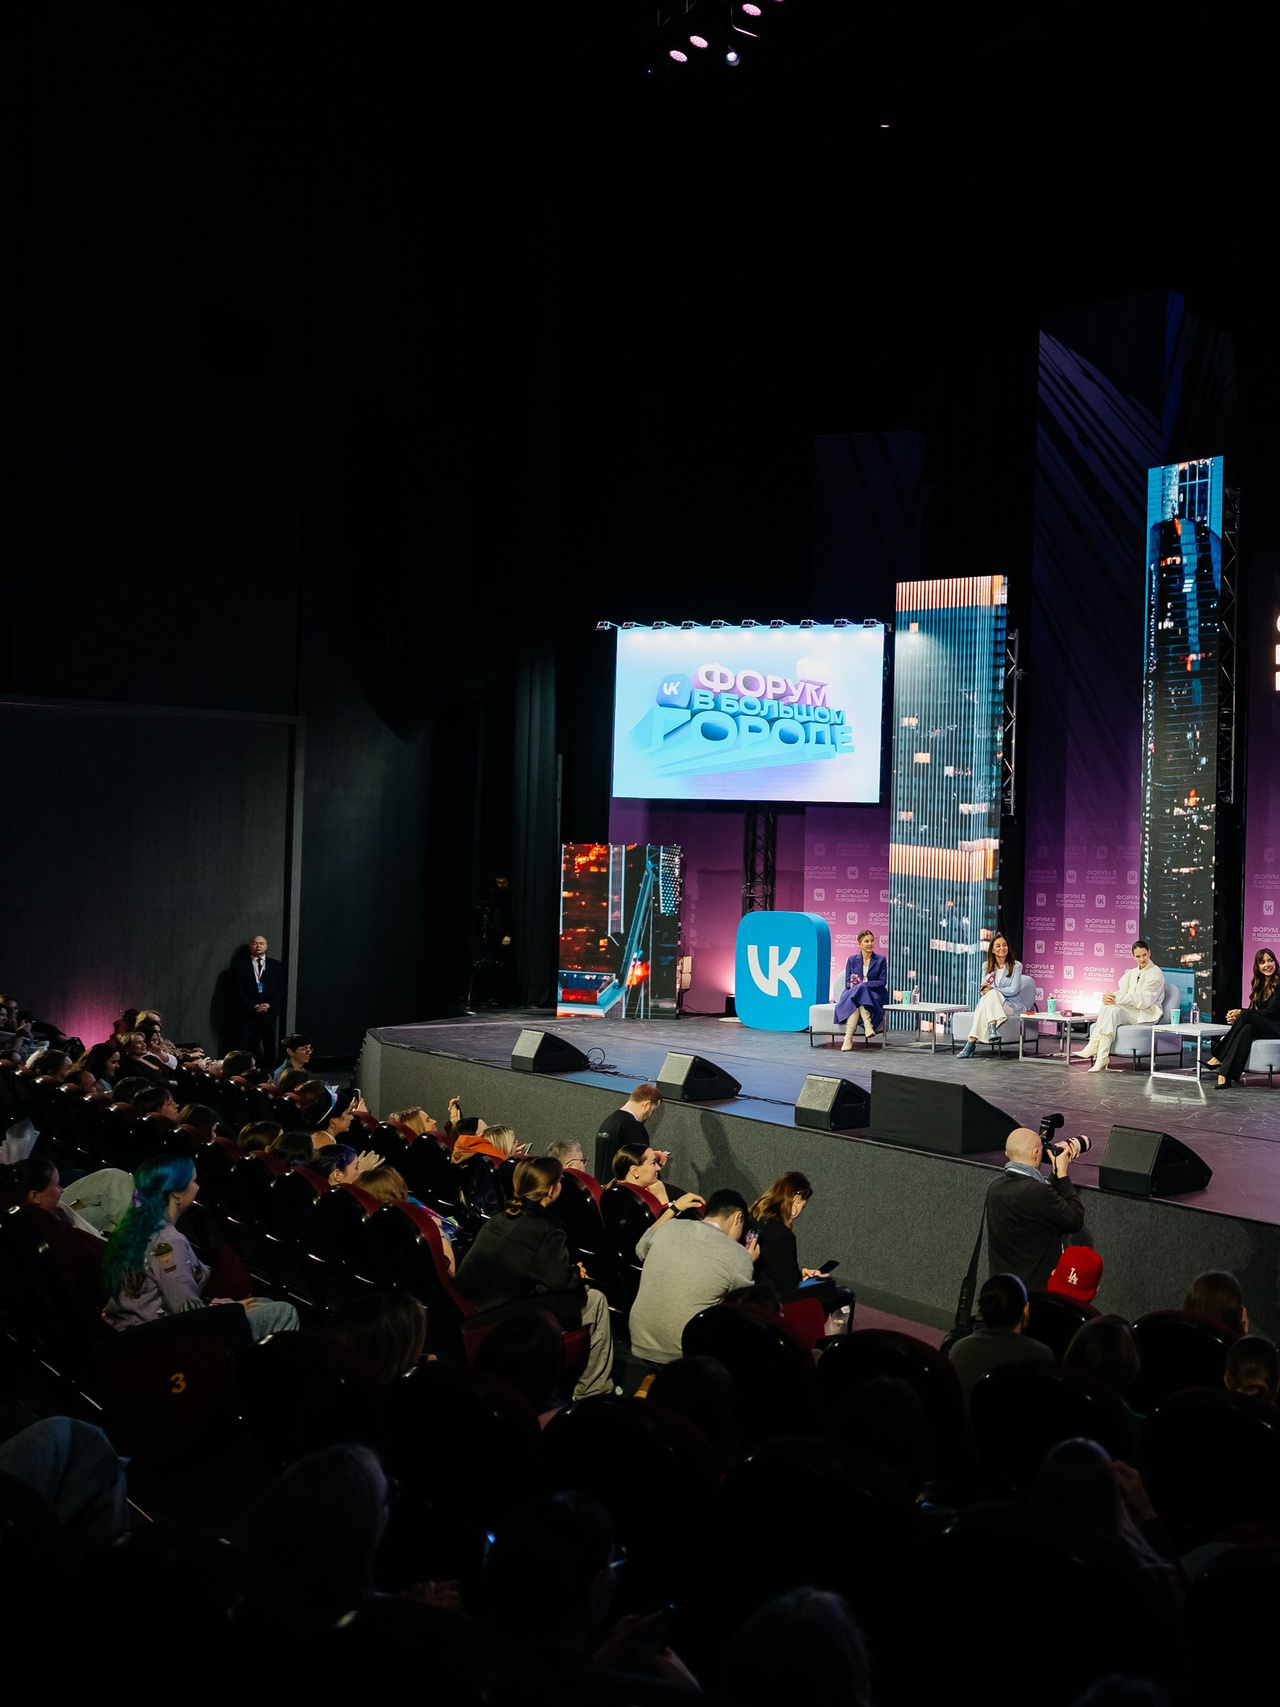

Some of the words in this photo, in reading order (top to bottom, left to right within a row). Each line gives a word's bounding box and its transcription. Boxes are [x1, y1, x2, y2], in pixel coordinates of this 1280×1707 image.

[663, 682, 680, 695] VK
[698, 663, 829, 706] ФОРУМ
[694, 689, 714, 710] В
[721, 692, 845, 724] БОЛЬШОМ
[652, 706, 854, 758] ГОРОДЕ
[747, 945, 802, 998] VK
[1068, 1267, 1078, 1284] LA
[170, 1373, 186, 1393] 3
